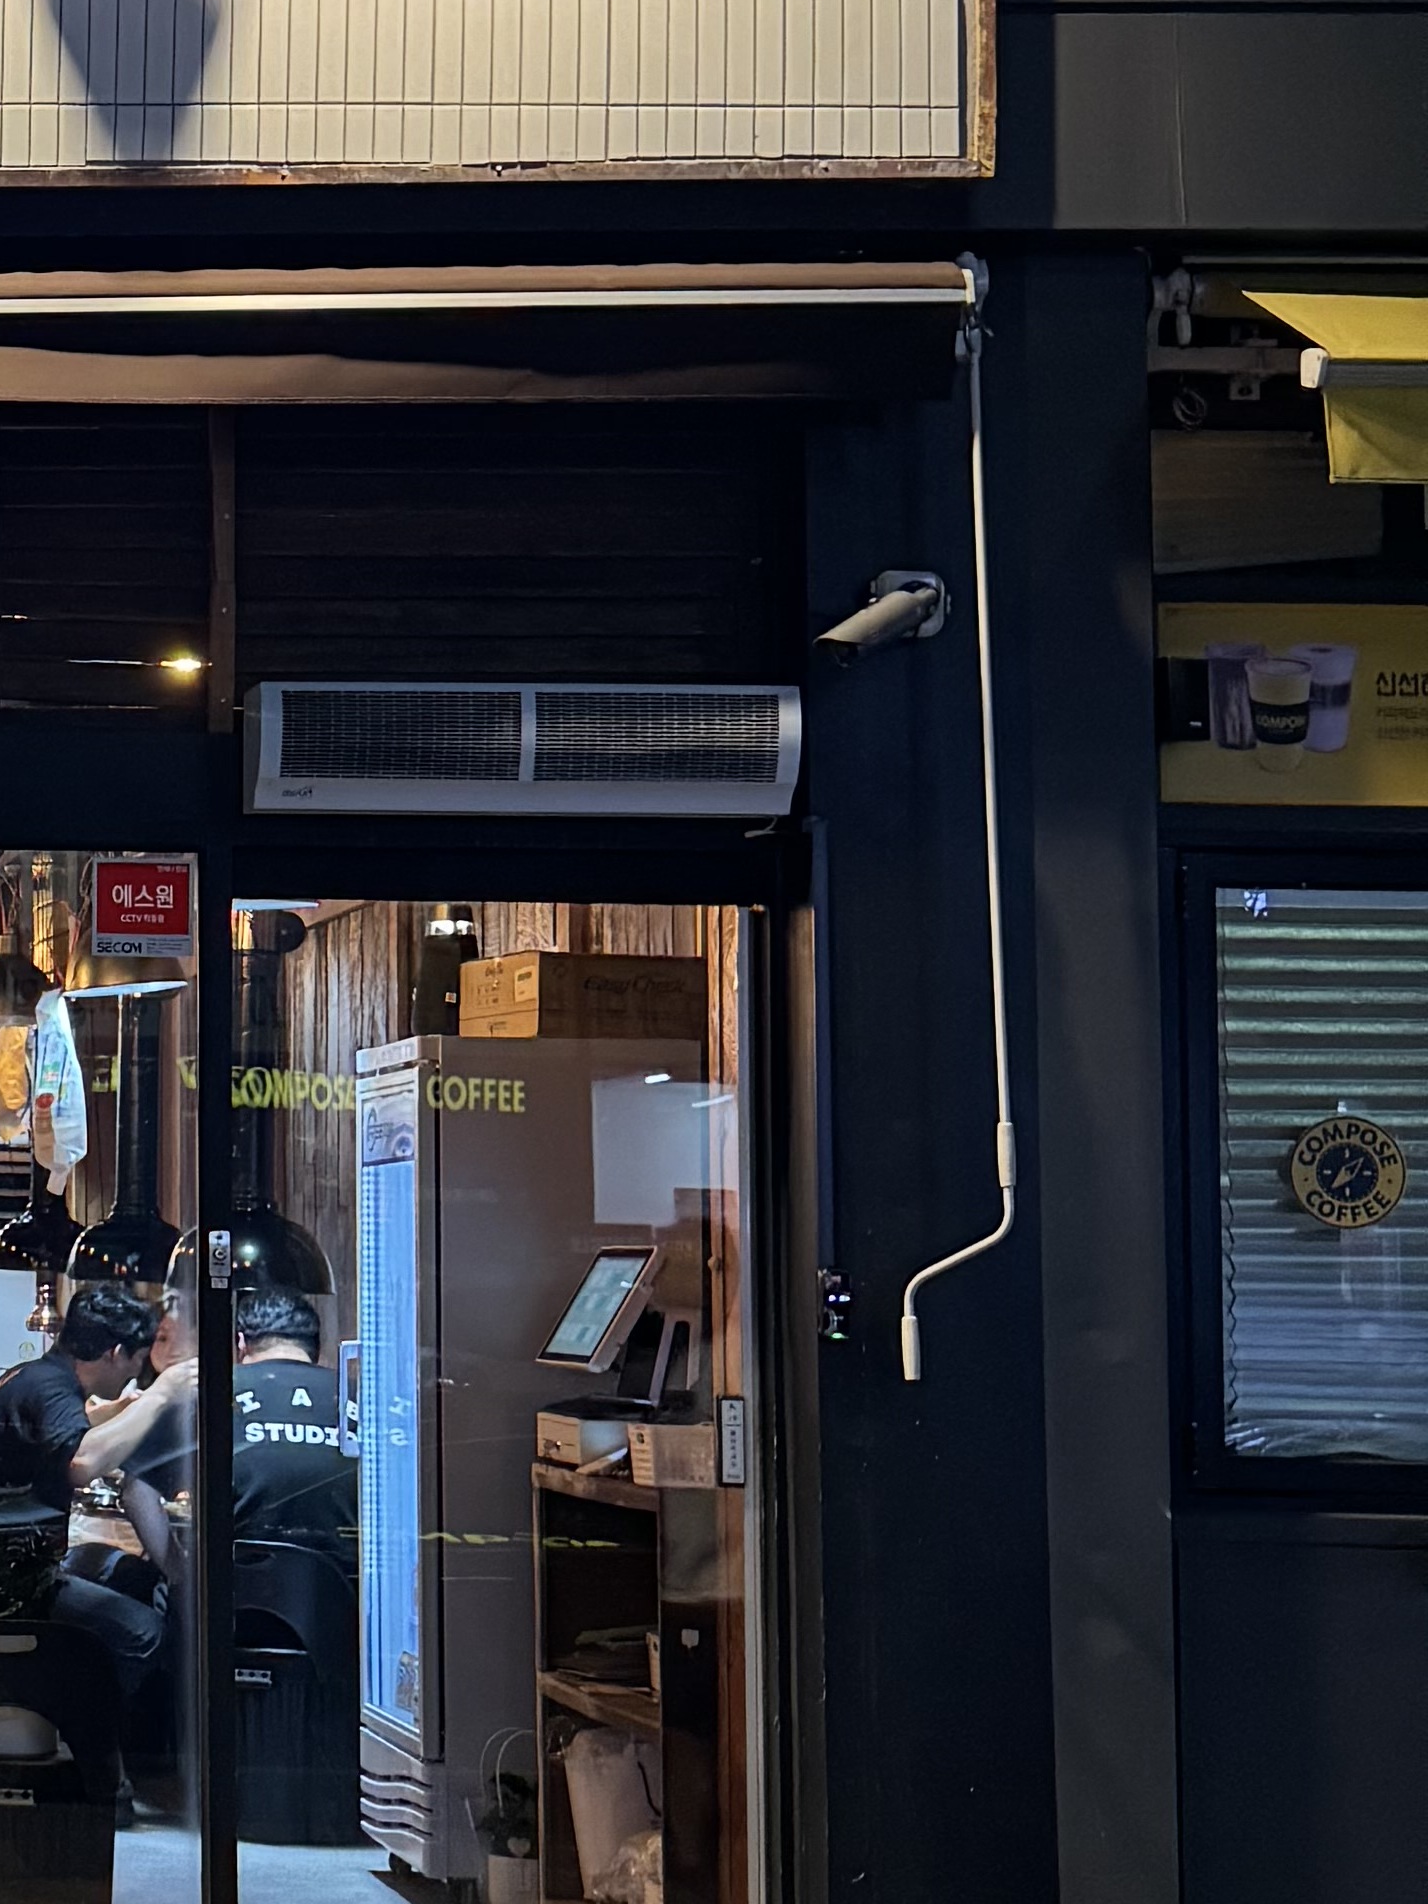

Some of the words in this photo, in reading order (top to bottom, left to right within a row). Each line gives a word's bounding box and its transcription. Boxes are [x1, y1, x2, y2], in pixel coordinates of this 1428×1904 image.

[111, 884, 174, 909] 에스원
[120, 914, 142, 923] CCTV
[96, 941, 142, 954] SECOM
[426, 1076, 526, 1113] COFFEE
[1298, 1121, 1398, 1168] COMPOSE
[1304, 1189, 1393, 1224] COFFEE
